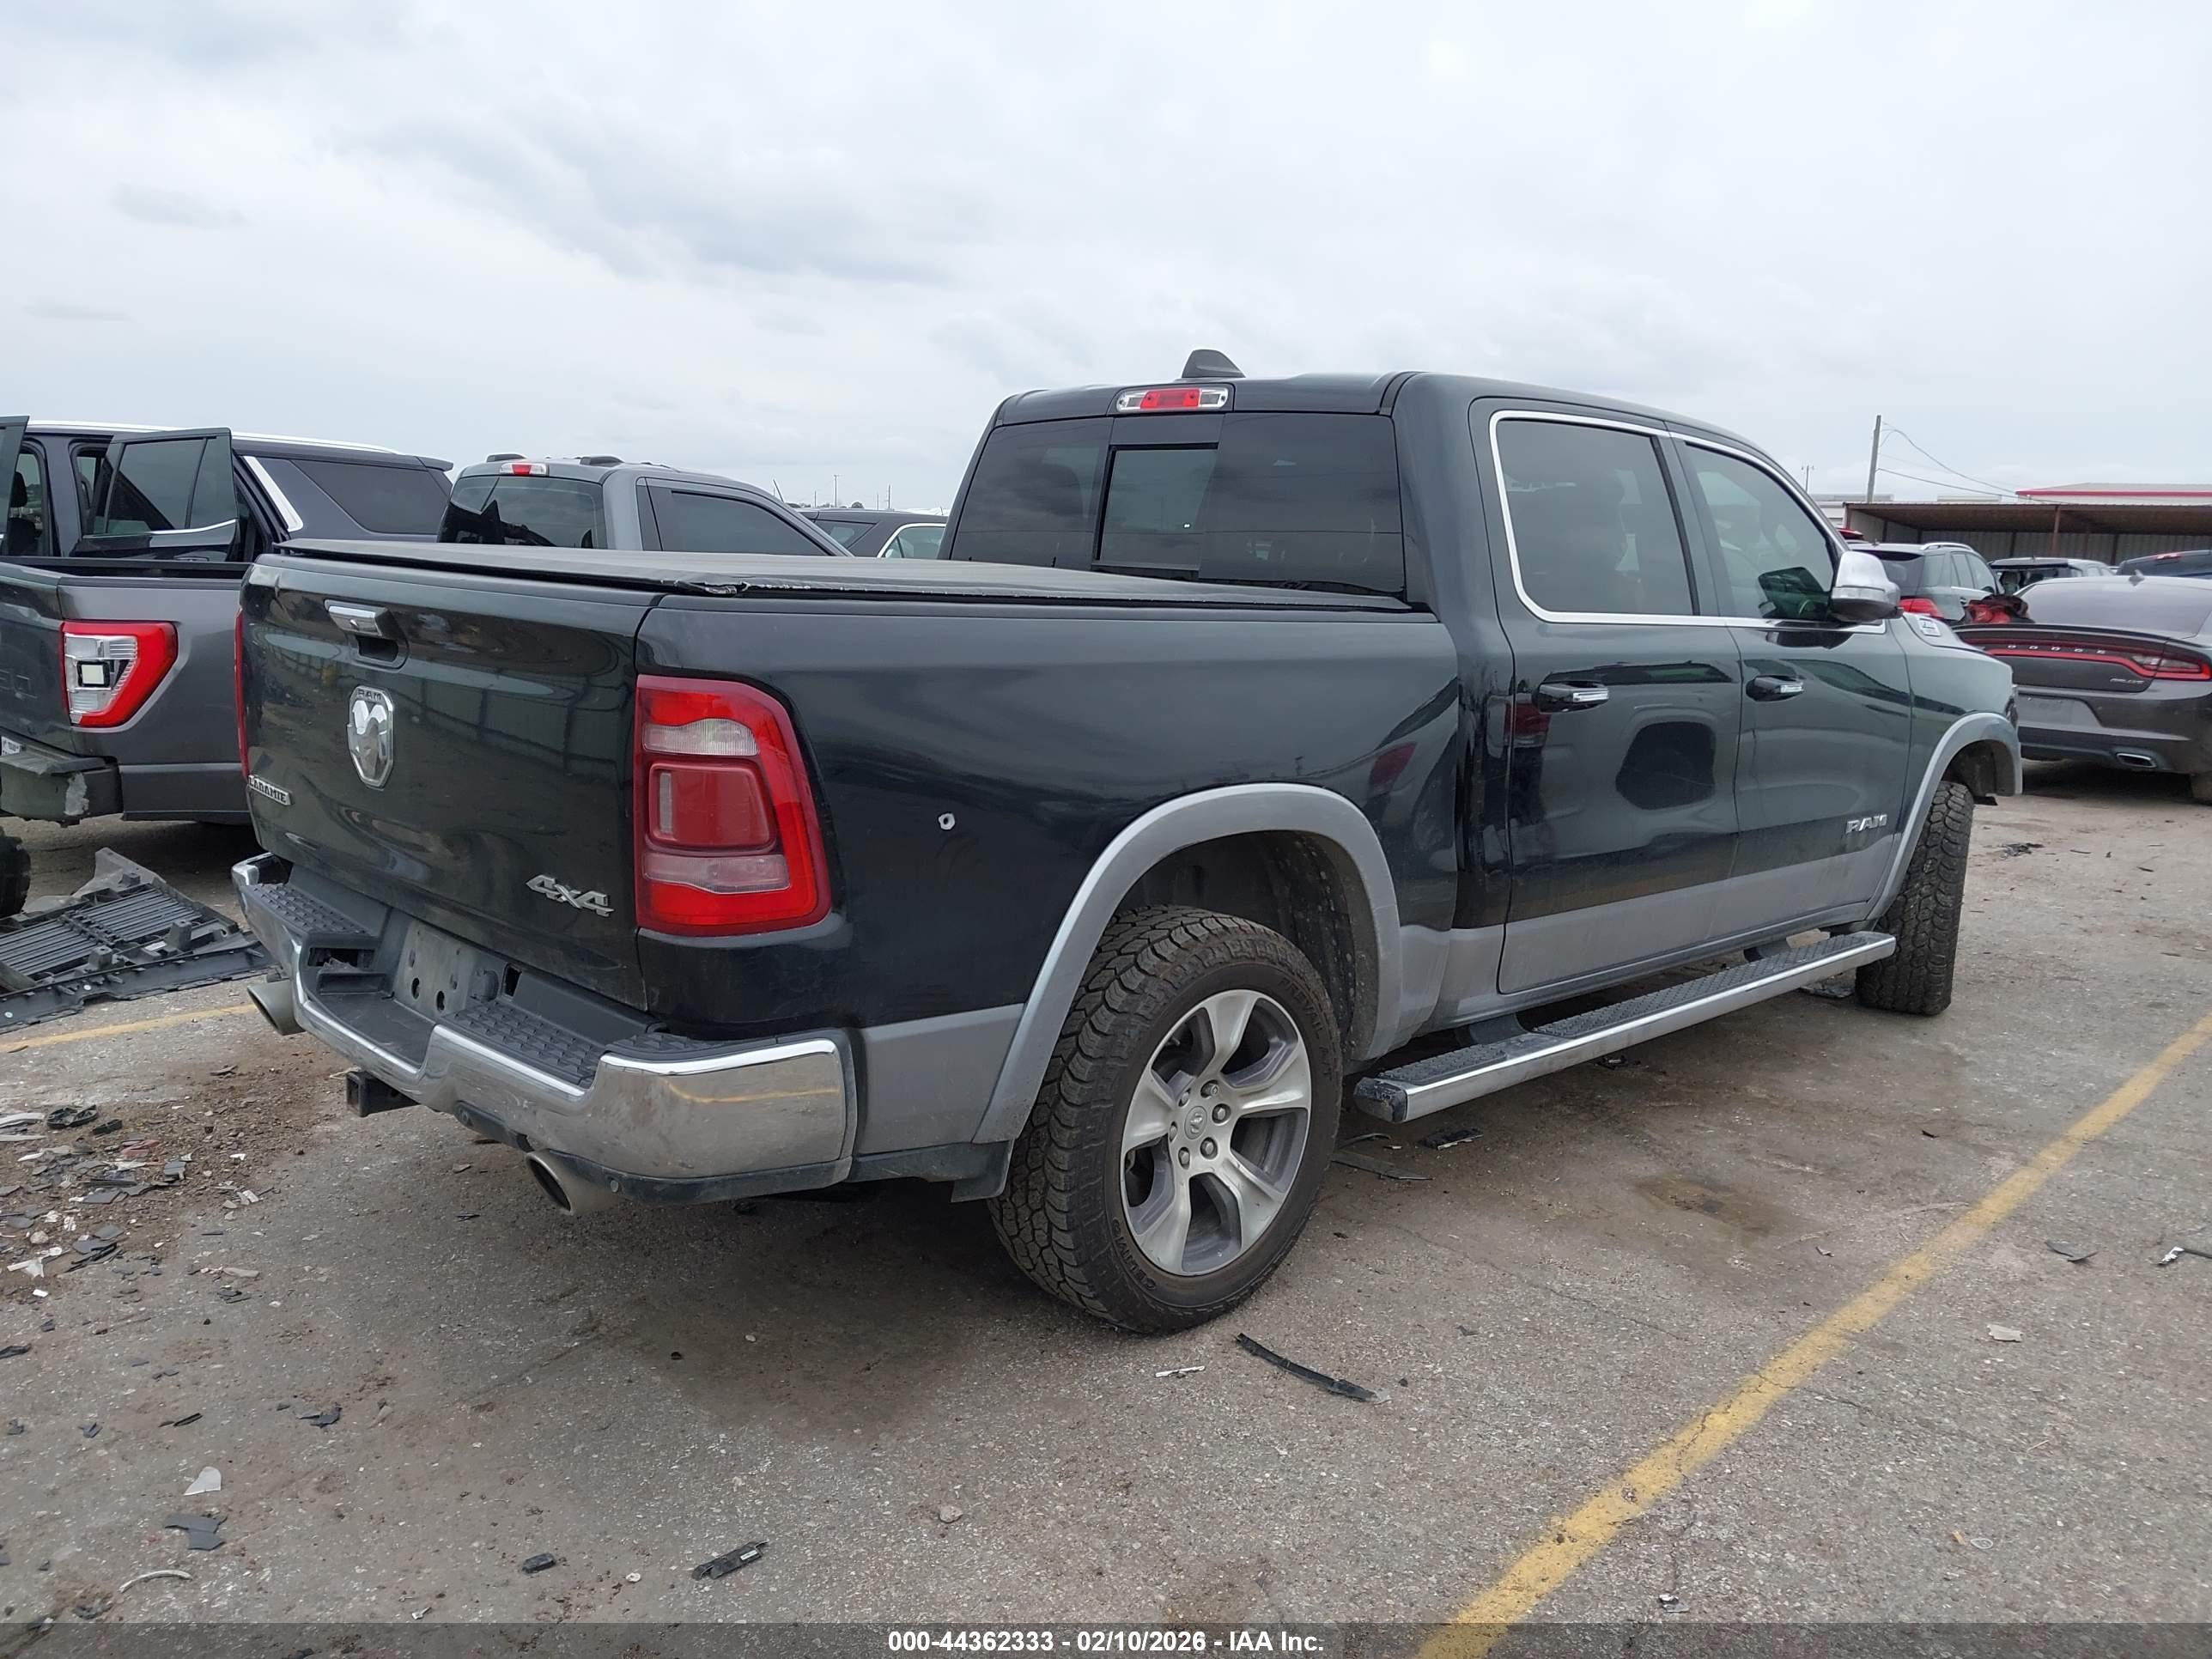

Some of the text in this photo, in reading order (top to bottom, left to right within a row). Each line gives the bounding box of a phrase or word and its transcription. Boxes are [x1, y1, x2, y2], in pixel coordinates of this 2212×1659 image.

[356, 688, 383, 702] RAM
[248, 775, 288, 804] LARAMIE
[1845, 813, 1887, 835] RAM
[1278, 976, 1323, 1041] PREVAIL
